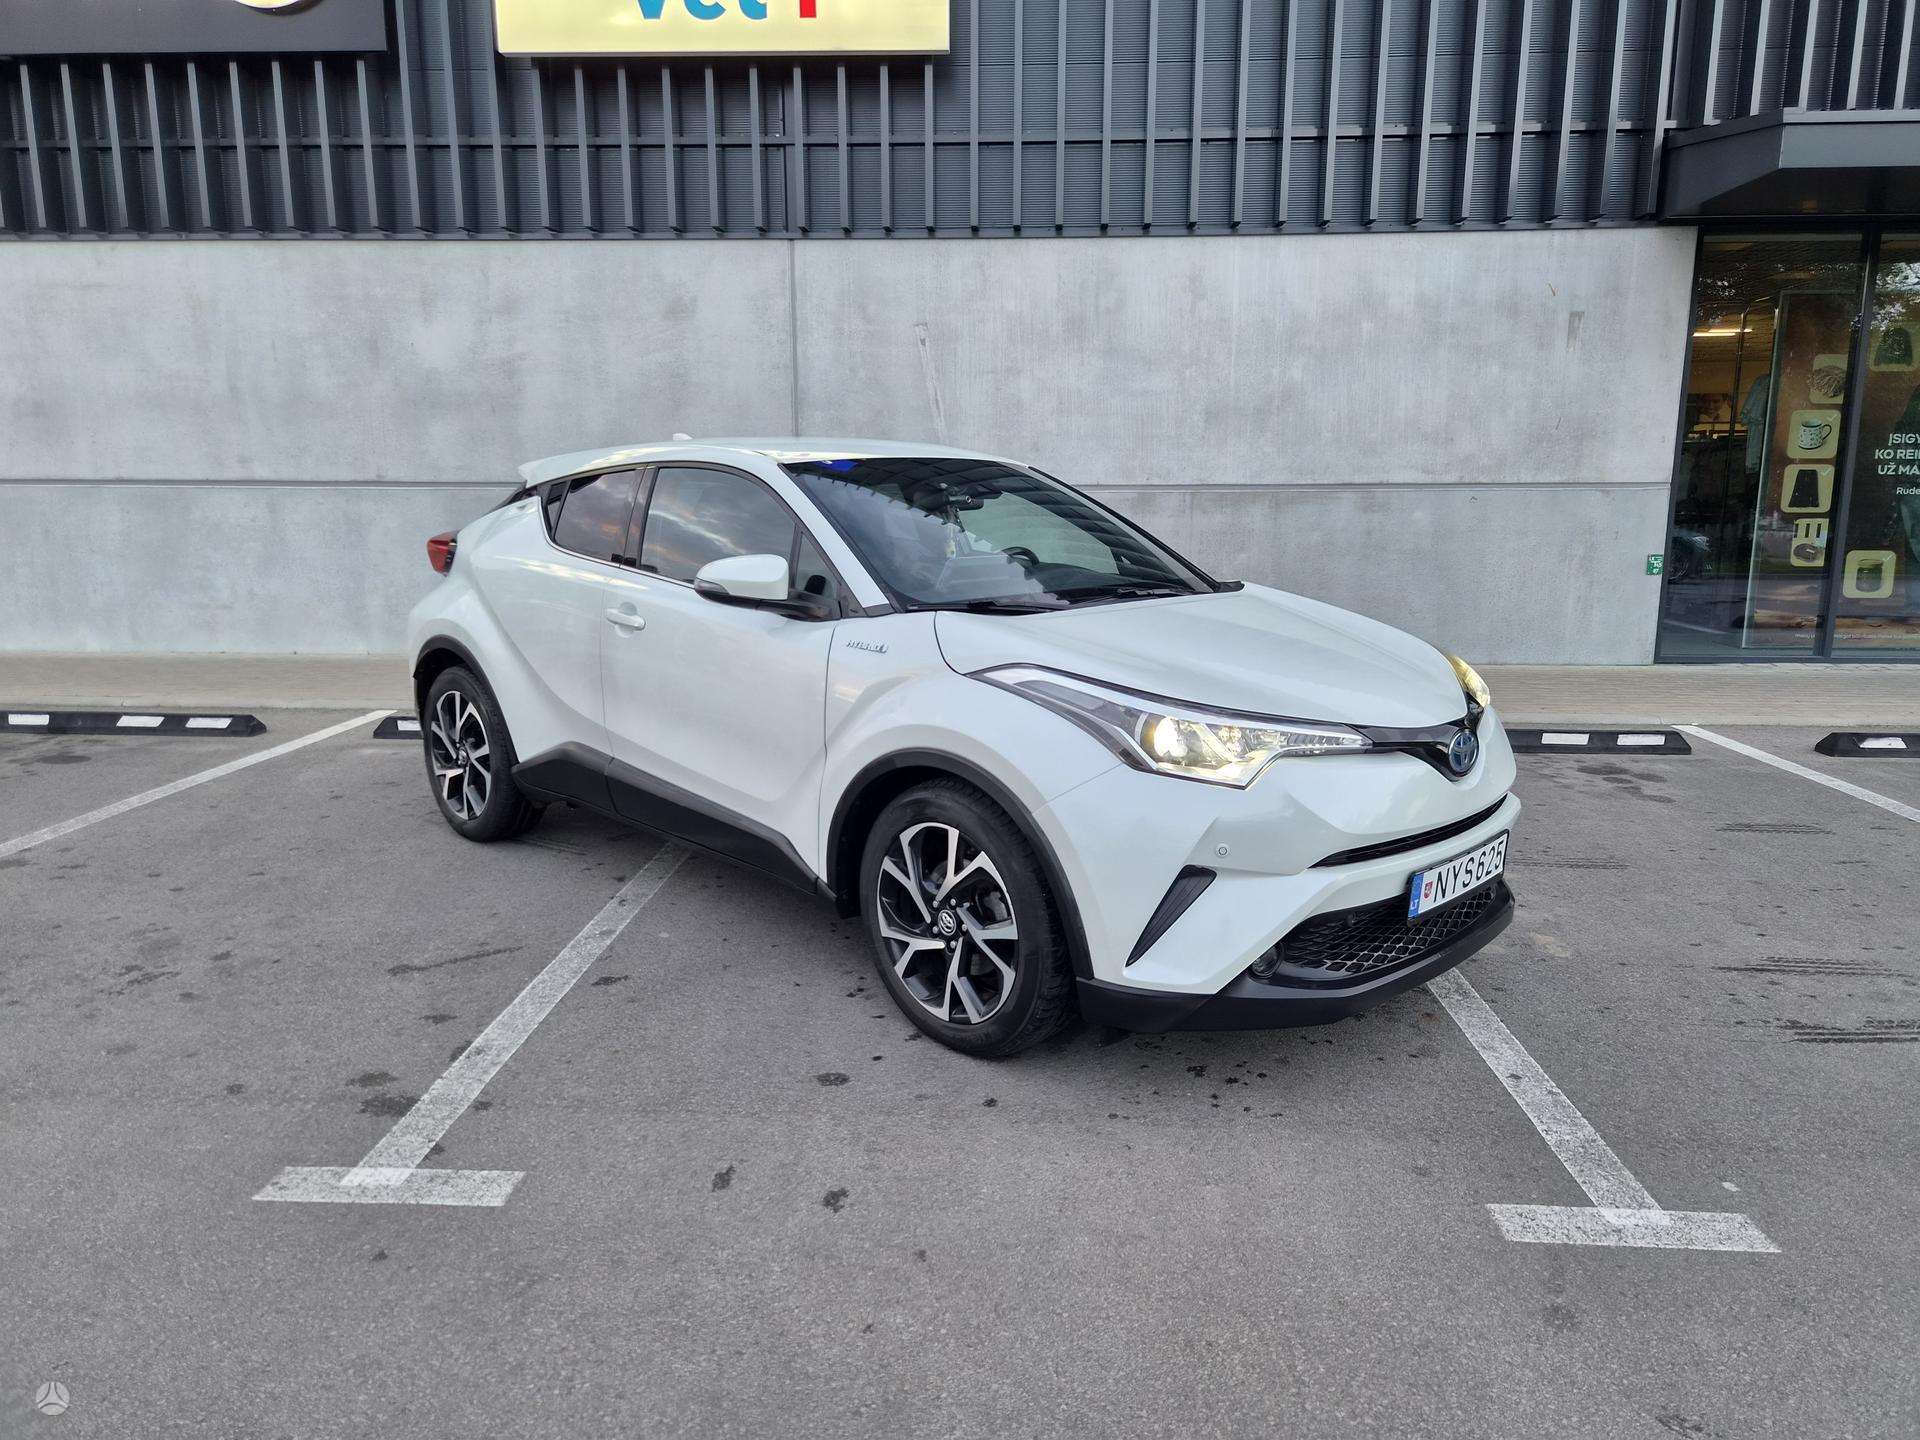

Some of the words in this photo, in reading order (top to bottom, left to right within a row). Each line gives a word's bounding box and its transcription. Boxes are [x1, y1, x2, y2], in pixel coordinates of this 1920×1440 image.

[1874, 449, 1894, 459] KO
[1896, 449, 1920, 459] REI
[1878, 462, 1896, 475] UŽ
[1433, 842, 1504, 903] NYS625
